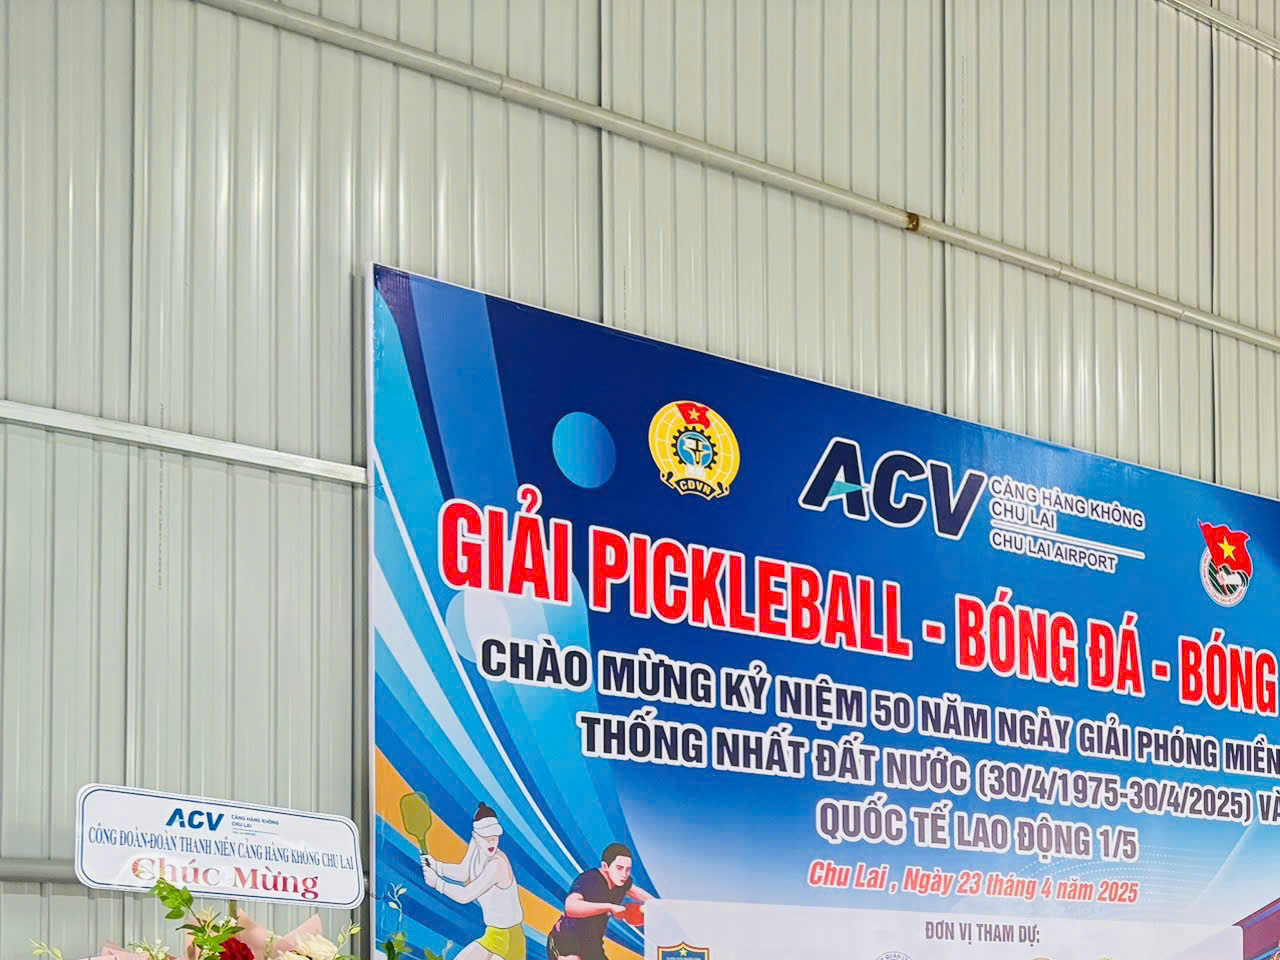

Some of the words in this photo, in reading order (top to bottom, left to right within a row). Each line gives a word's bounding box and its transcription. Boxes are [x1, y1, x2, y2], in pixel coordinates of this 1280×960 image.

[800, 437, 987, 539] ACV
[1041, 488, 1086, 514] HÀNG
[1090, 501, 1144, 528] KHÔNG
[991, 501, 1026, 522] CHU
[1030, 509, 1055, 529] LAI
[991, 532, 1024, 551] CHU
[1028, 538, 1051, 558] LAI
[1054, 544, 1116, 571] AIRPORT
[440, 486, 571, 604] GIẢI
[590, 526, 911, 657] PICKLEBALL
[957, 588, 1076, 686] BÓNG
[1088, 613, 1144, 696] ĐÁ
[1179, 630, 1278, 715] BÓNG
[480, 637, 590, 688] CHÀO
[601, 653, 713, 704] MỪNG
[724, 664, 769, 711] KỶ
[779, 678, 864, 726] NIỆM
[873, 692, 912, 729] 50
[920, 696, 989, 740] NĂM
[998, 709, 1071, 751] NGÀY
[1078, 715, 1130, 758] GIẢI
[1137, 727, 1218, 769] PHÓNG
[579, 708, 704, 764] THỐNG
[715, 724, 806, 776] NHẤT
[814, 735, 877, 782] ĐẤT
[886, 749, 969, 792] NƯỚC
[978, 762, 1252, 825] (30/4/1975-30/4/2025)
[165, 807, 225, 832] ACV
[818, 795, 904, 842] QUỐC
[912, 803, 950, 846] TẾ
[957, 814, 1008, 850] LAO
[1016, 815, 1091, 861] ĐỘNG
[1099, 828, 1137, 860] 1/5
[88, 822, 117, 846] CÔNG
[179, 836, 212, 855] THANH
[321, 851, 339, 869] CHU
[340, 853, 354, 870] LAI
[131, 857, 221, 886] Chúc
[231, 865, 319, 899] Mừng
[808, 861, 850, 887] Chu
[854, 864, 889, 889] Lai
[903, 866, 953, 896] Ngày
[957, 871, 981, 894] 23
[986, 875, 1038, 901] tháng
[1041, 878, 1051, 899] 4
[1056, 879, 1094, 901] năm
[1099, 880, 1139, 903] 2025
[925, 921, 955, 941] ĐƠN
[958, 922, 972, 945] VỊ
[976, 923, 1015, 943] THAM
[1018, 925, 1040, 947] DỰ:
